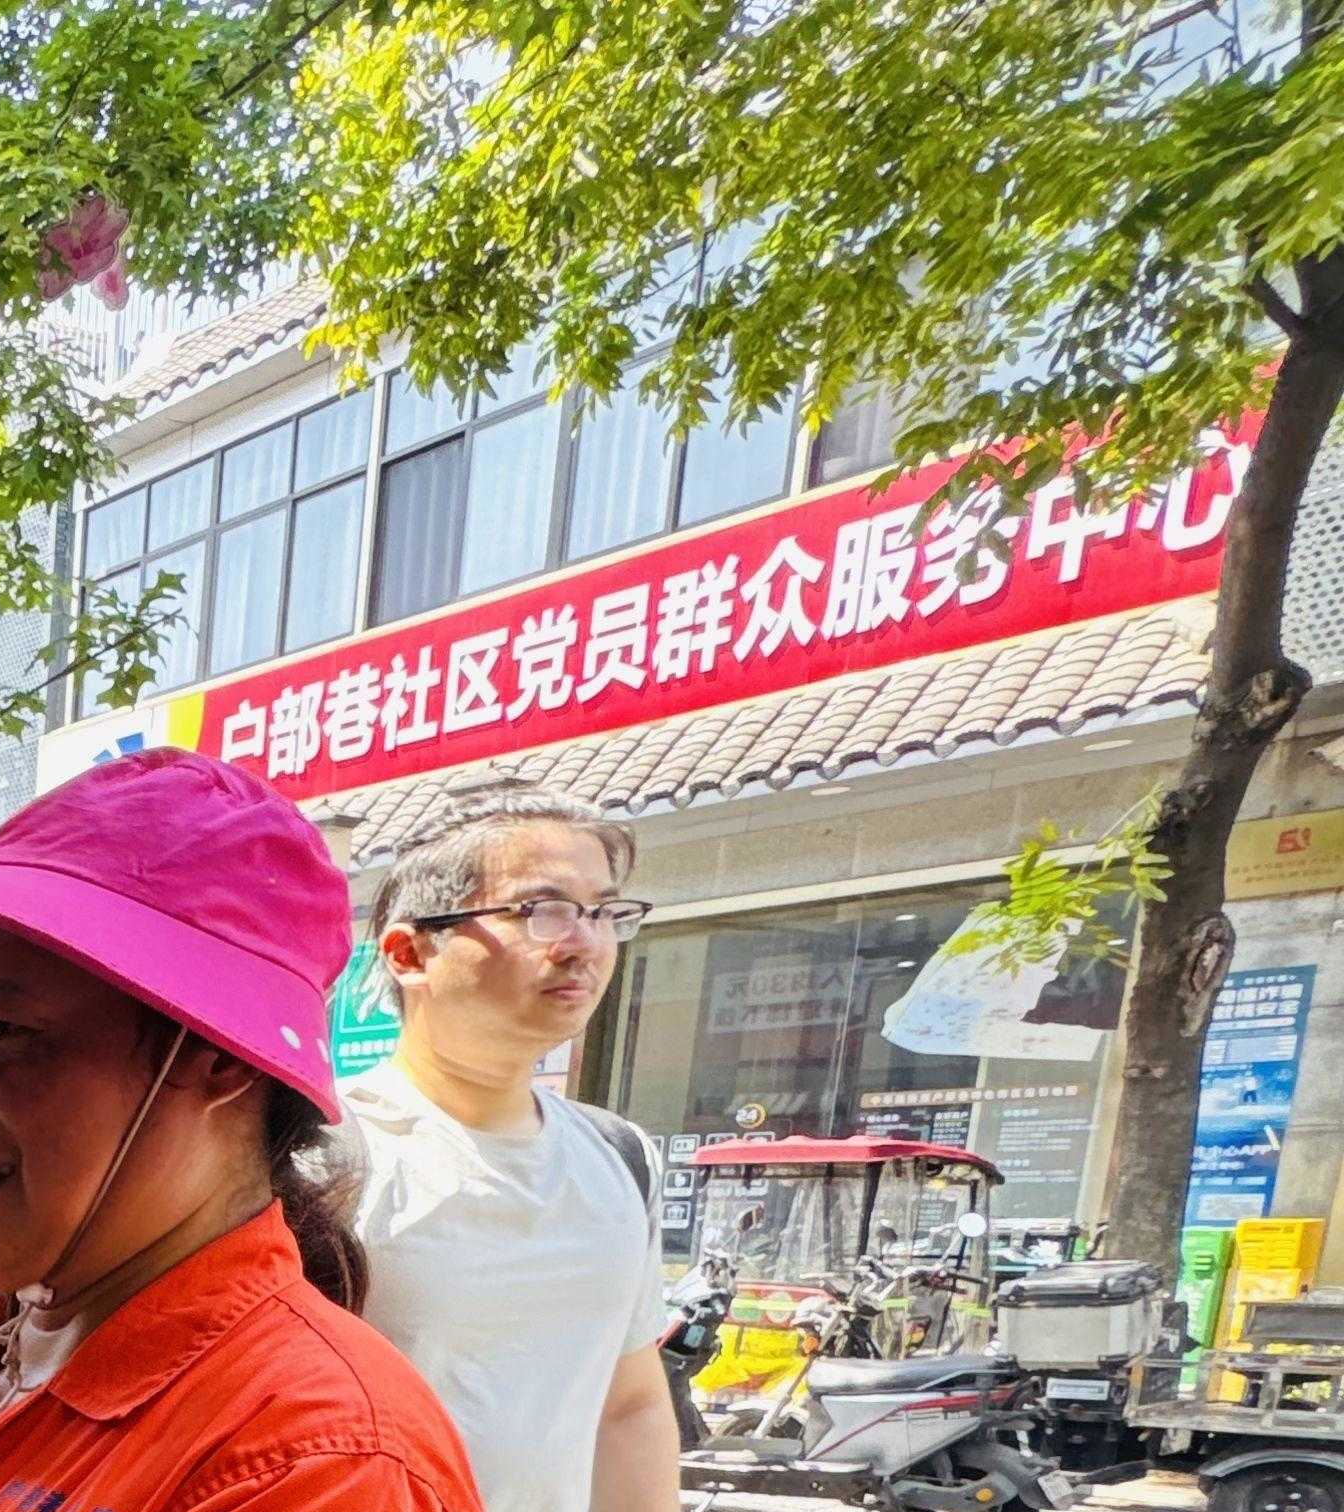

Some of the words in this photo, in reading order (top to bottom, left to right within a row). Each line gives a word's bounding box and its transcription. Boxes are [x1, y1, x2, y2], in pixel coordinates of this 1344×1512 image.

[220, 427, 1254, 779] 户部巷社区党员群众服务中心
